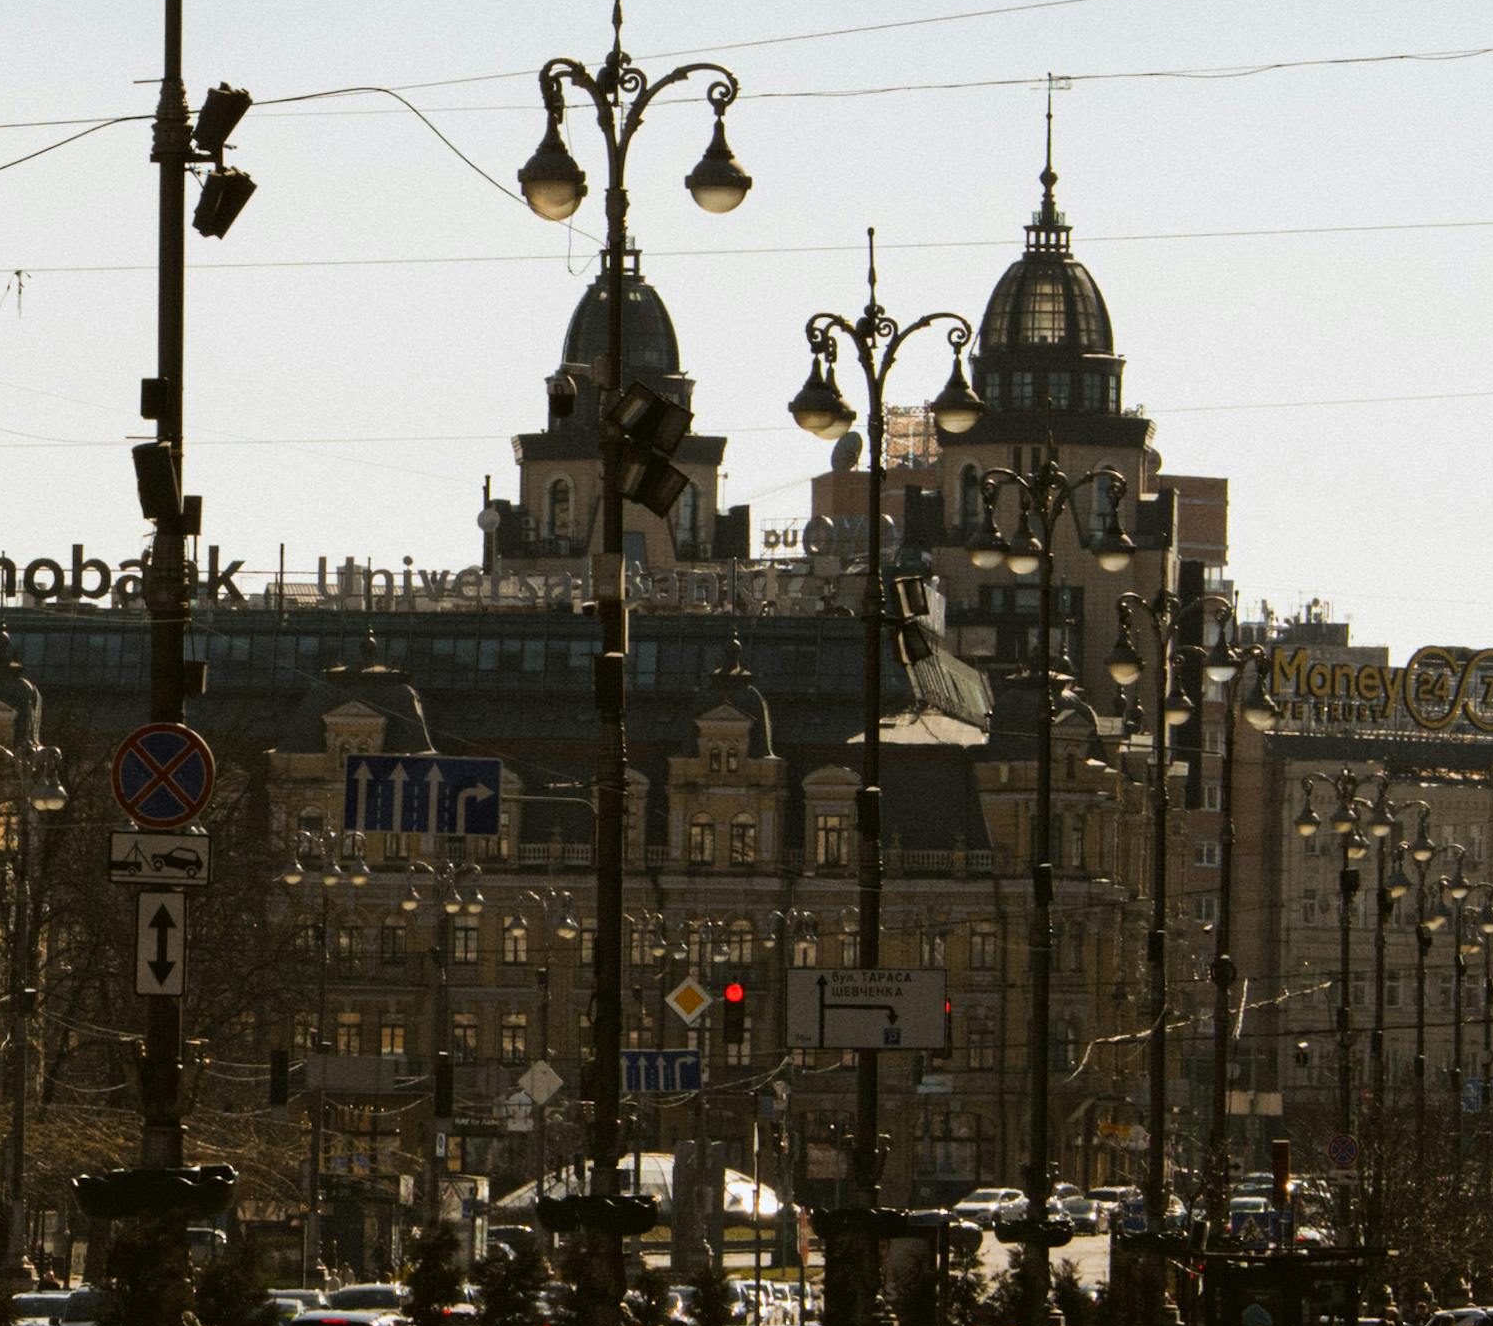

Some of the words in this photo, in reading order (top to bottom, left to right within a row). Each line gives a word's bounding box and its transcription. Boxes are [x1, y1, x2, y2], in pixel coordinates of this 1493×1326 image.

[1272, 647, 1403, 719] Money
[863, 973, 912, 983] ТАРАСА
[831, 987, 903, 997] ШЕВЧЕНКА
